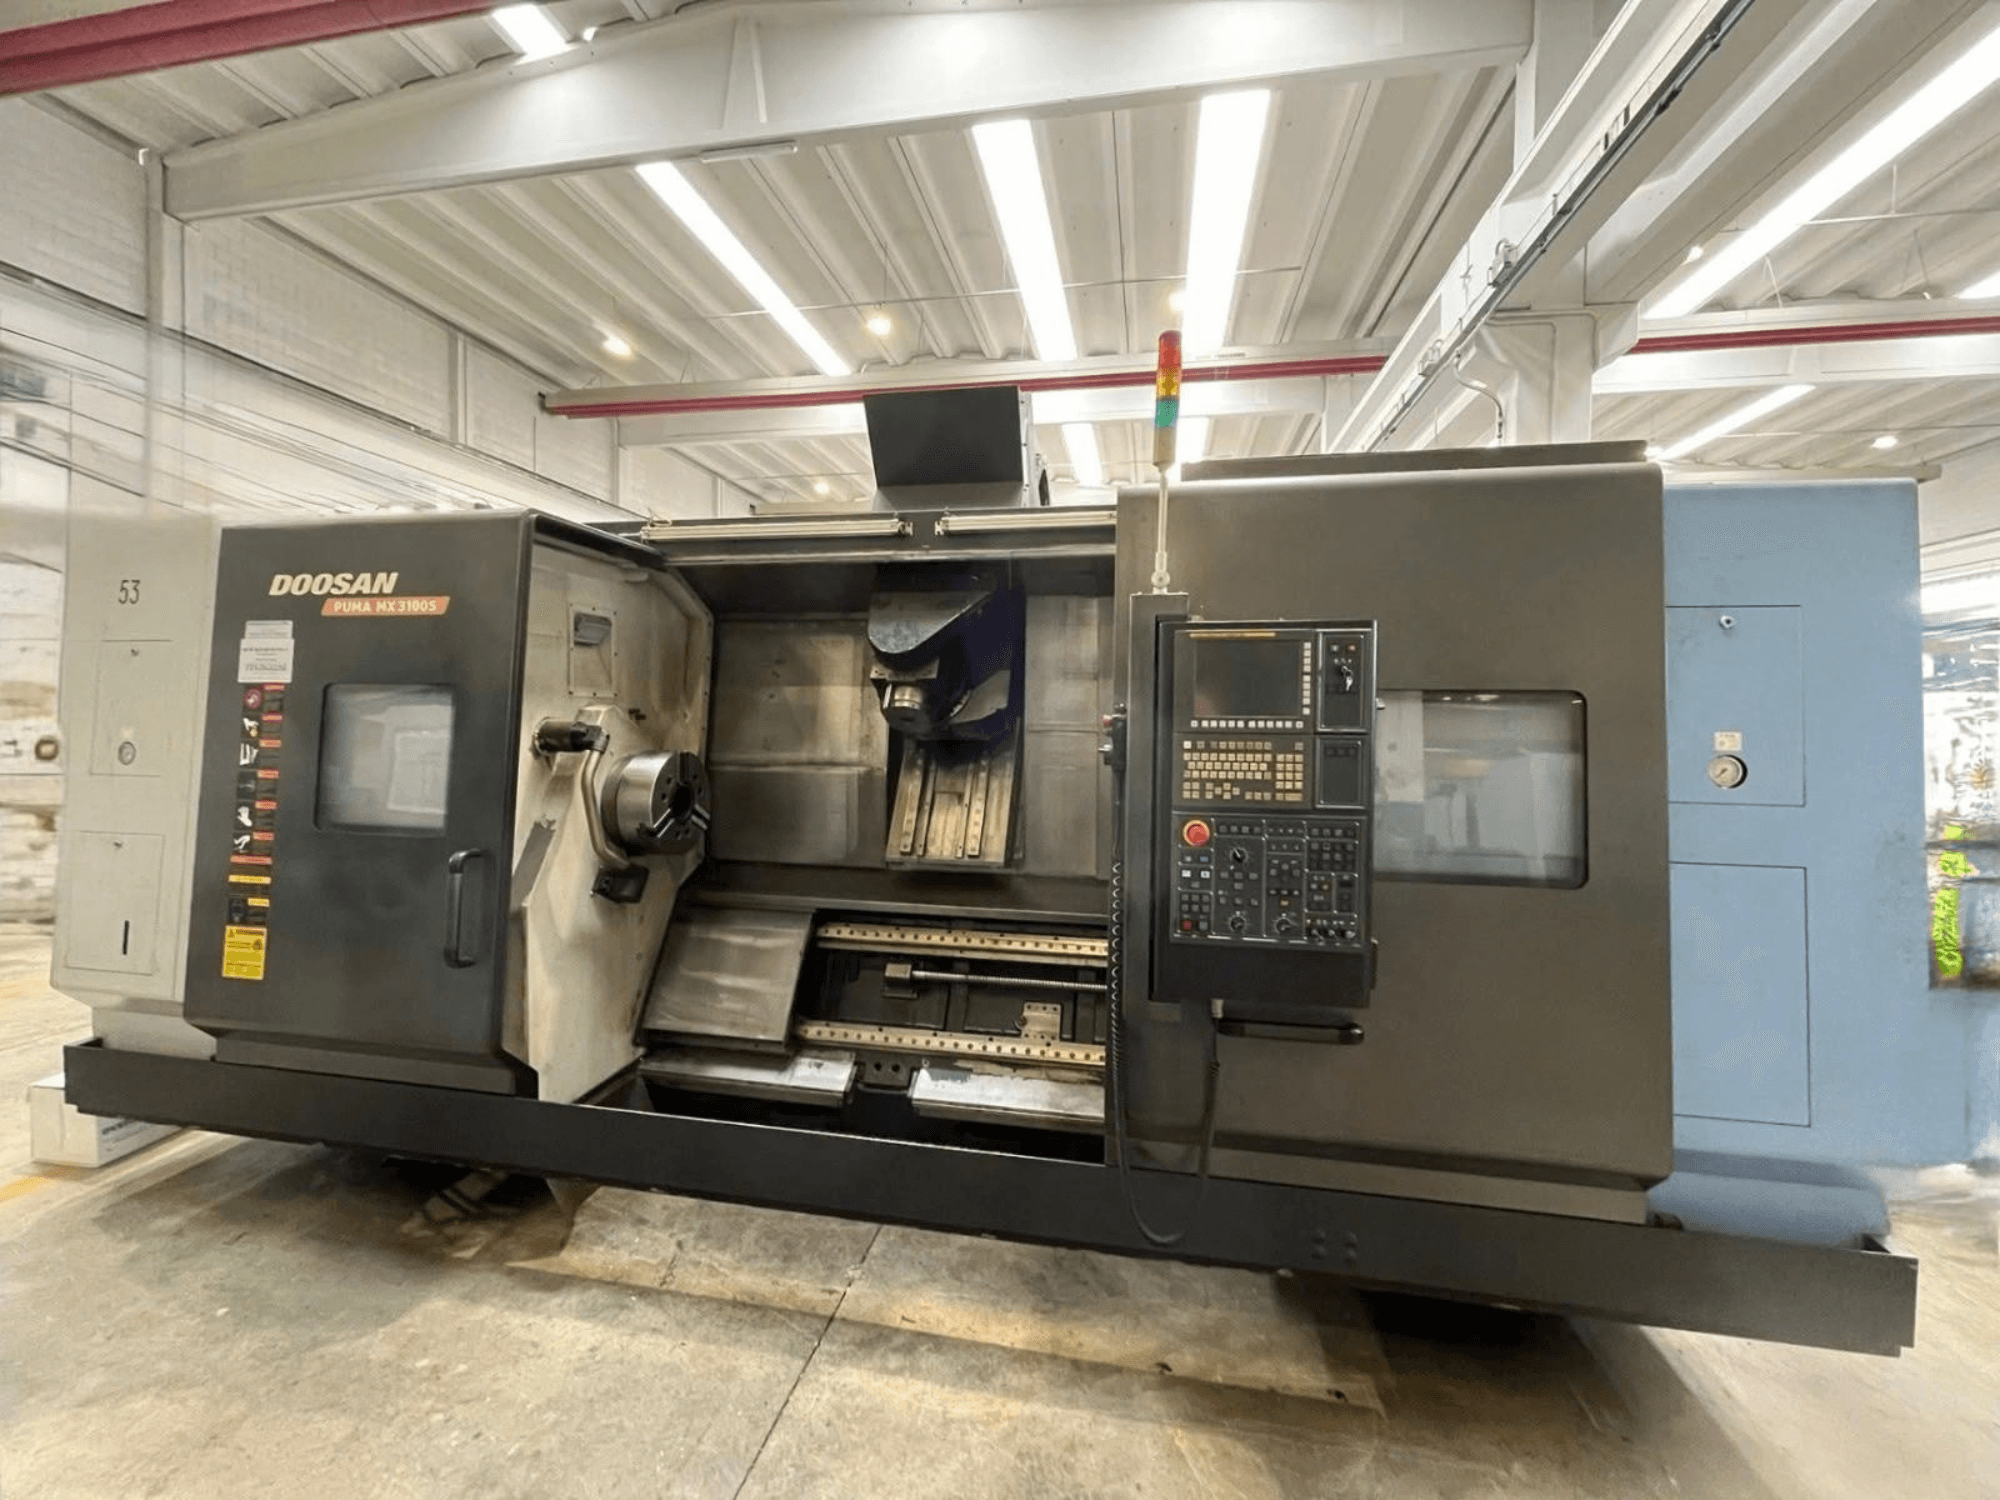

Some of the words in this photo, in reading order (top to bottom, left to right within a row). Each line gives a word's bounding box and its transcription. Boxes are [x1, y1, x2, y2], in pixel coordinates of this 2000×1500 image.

[118, 579, 140, 605] 53
[268, 572, 399, 596] DOOSAN
[333, 601, 371, 613] PUMA
